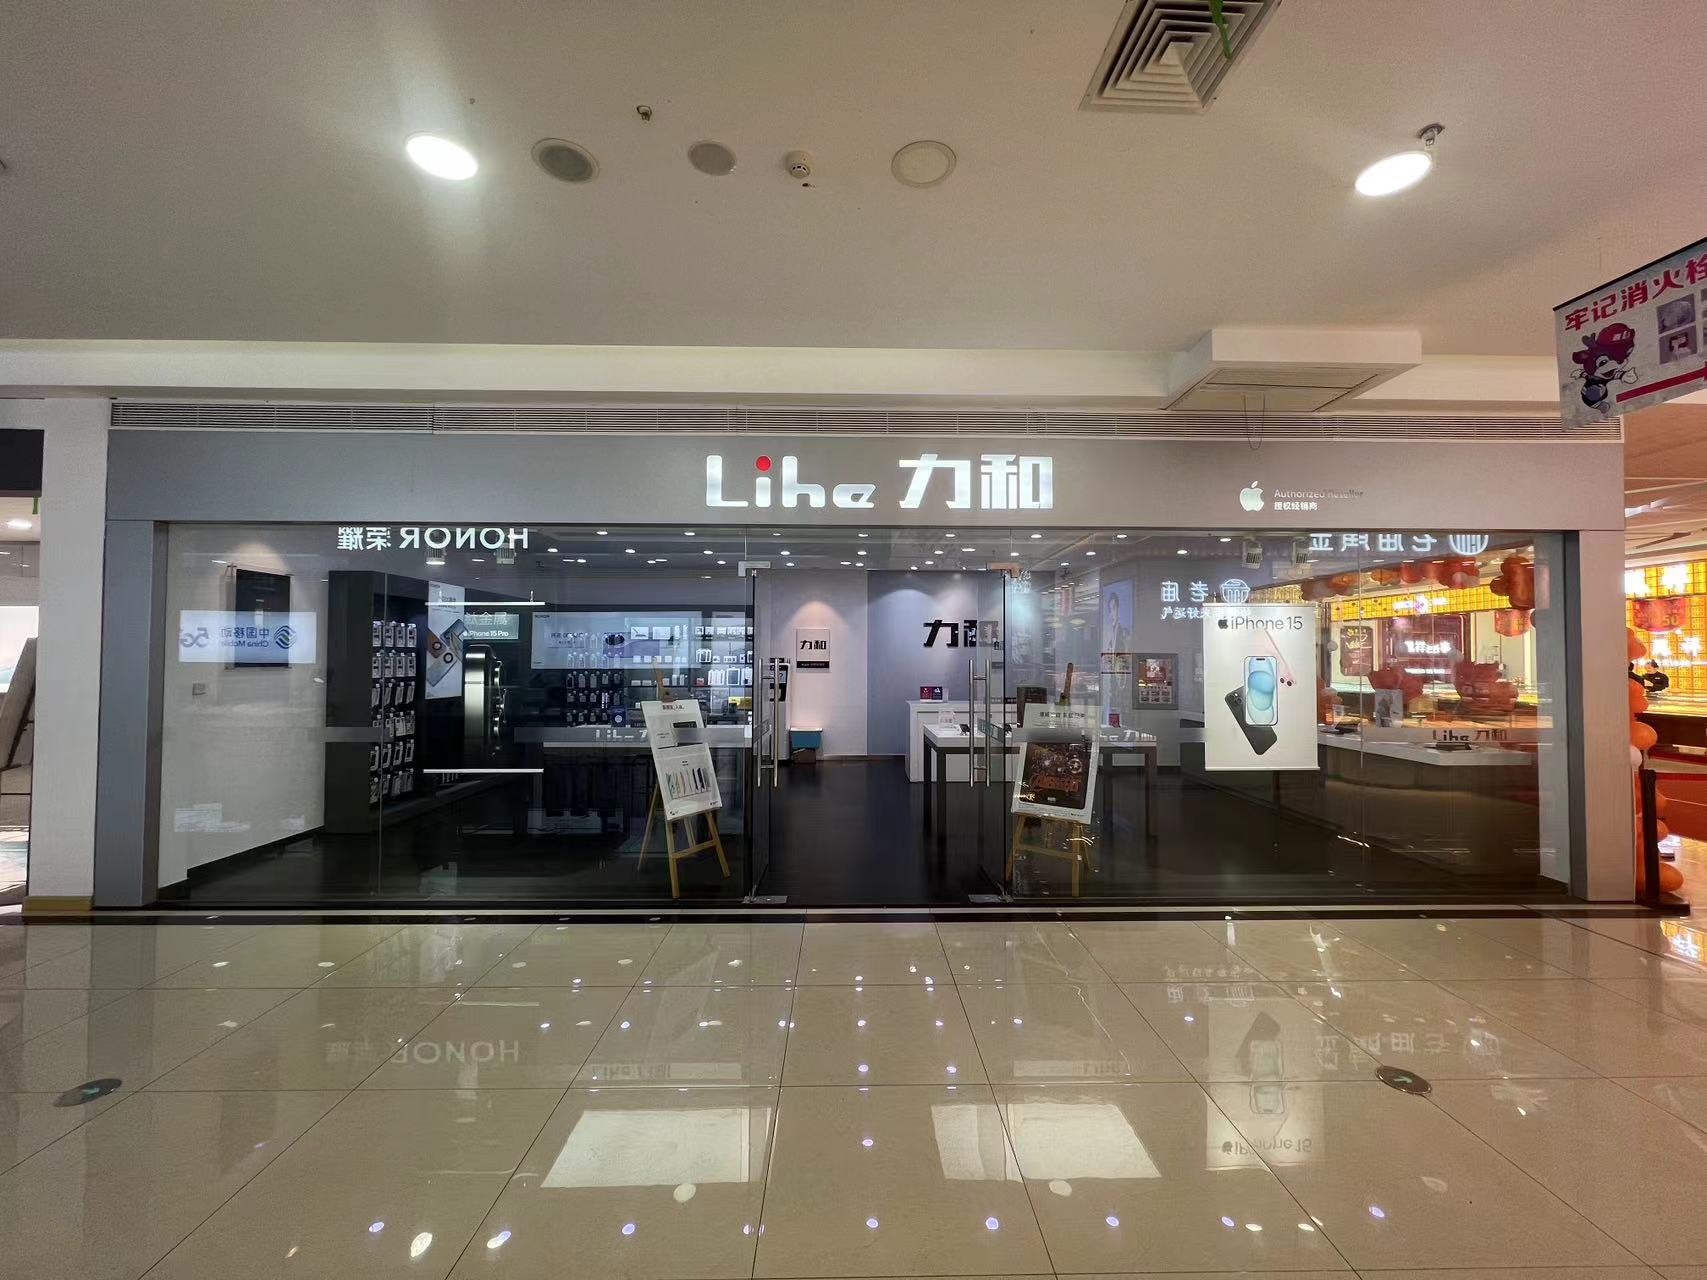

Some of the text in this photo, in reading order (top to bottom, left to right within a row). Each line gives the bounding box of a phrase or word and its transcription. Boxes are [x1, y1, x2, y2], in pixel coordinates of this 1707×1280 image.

[706, 453, 1053, 509] Lihe 力和
[1274, 489, 1325, 498] Authorized
[1230, 616, 1303, 630] iPhone 15
[800, 640, 827, 650] 力和
